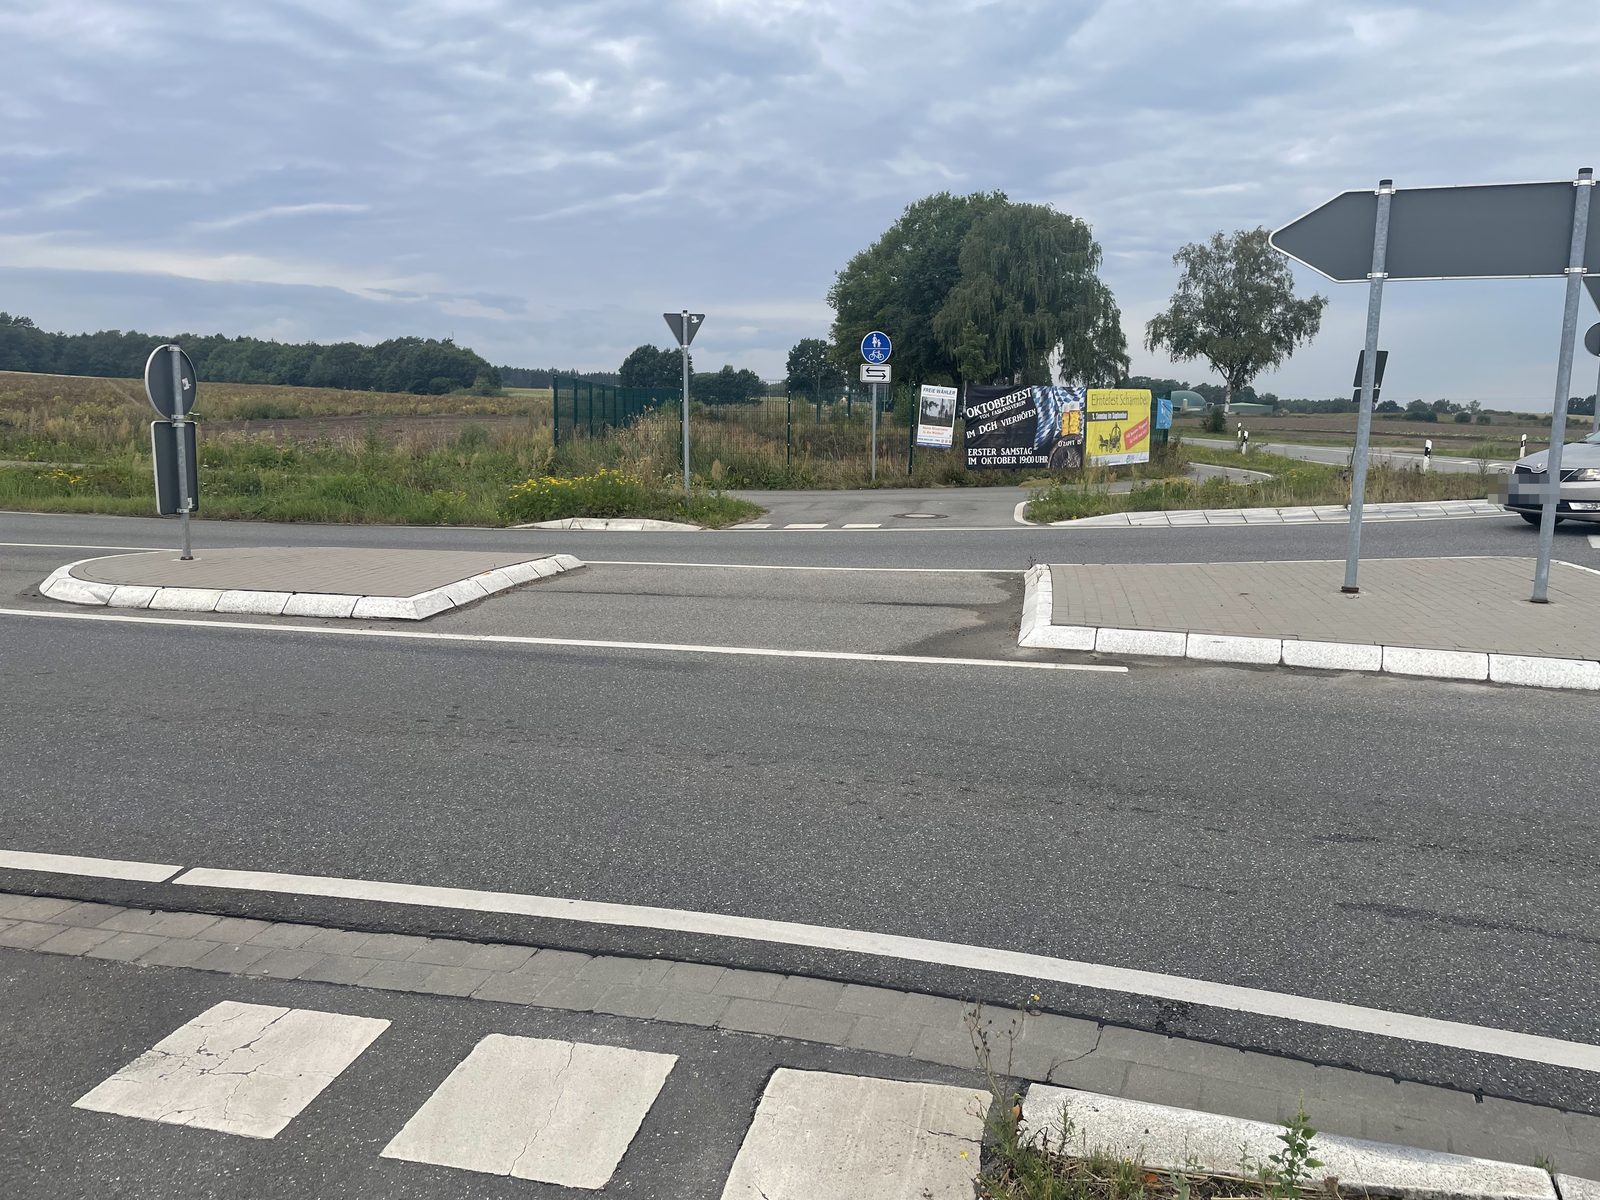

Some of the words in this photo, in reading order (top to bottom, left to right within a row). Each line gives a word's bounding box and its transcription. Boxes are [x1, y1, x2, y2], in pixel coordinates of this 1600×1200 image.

[966, 388, 1032, 418] OKTOBERFEST
[1091, 391, 1119, 406] Erntefest
[966, 429, 975, 439] IM
[978, 420, 998, 434] DGH
[1000, 408, 1037, 427] VIERHÖFEN
[967, 448, 997, 456] ERSTER
[1000, 447, 1033, 456] SAMSTAG
[968, 457, 977, 465] IM
[981, 456, 1017, 465] OKTOBER
[1035, 455, 1049, 463] UHR
